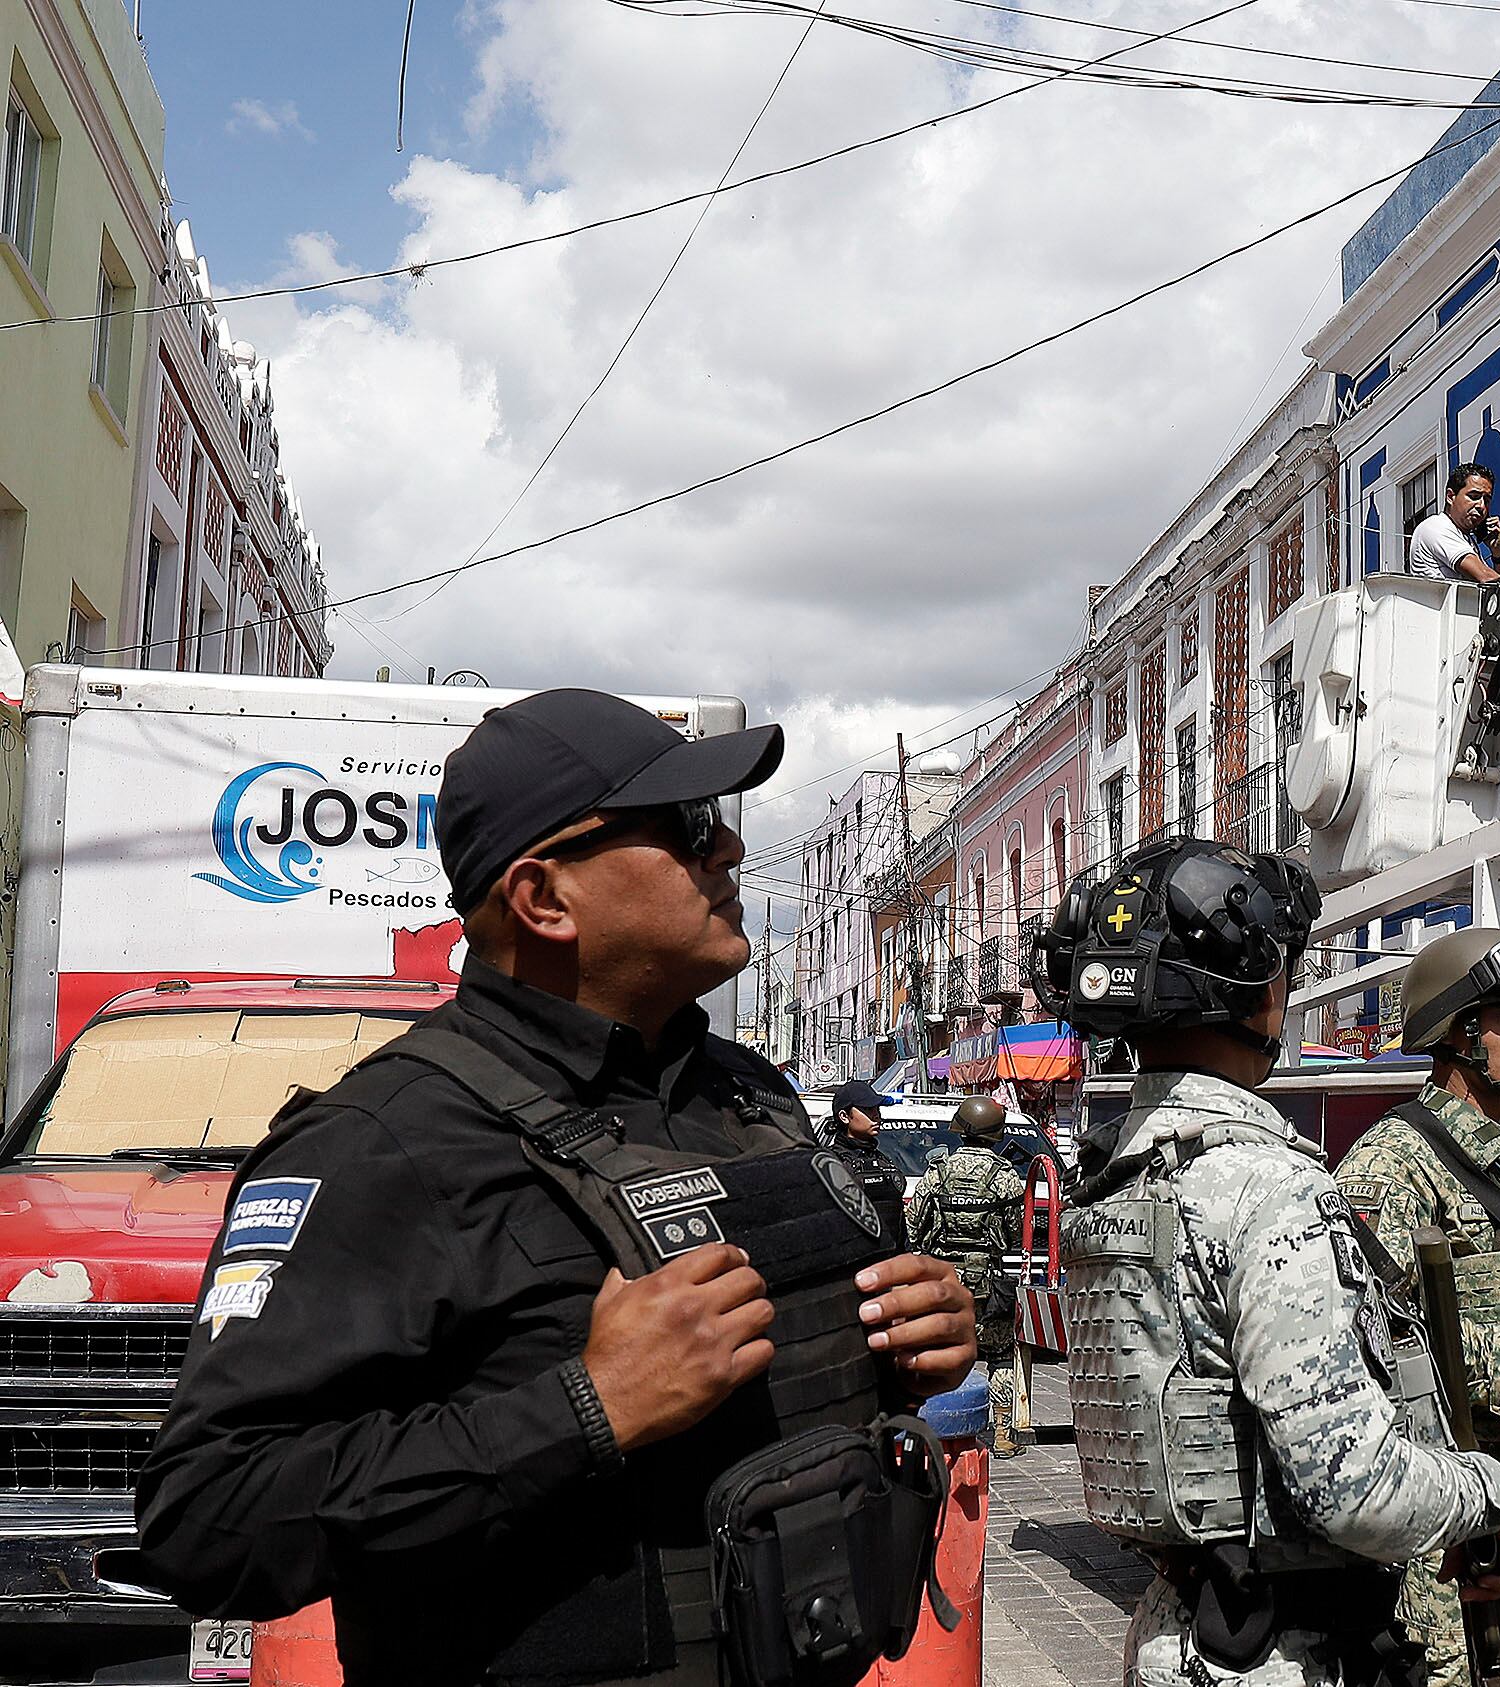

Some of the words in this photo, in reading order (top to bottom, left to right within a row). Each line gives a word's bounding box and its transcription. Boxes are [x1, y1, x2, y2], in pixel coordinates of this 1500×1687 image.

[329, 889, 437, 908] Pescados
[1111, 967, 1137, 983] GN
[630, 1175, 718, 1208] DOBERMAN
[234, 1198, 303, 1219] FUERZAS
